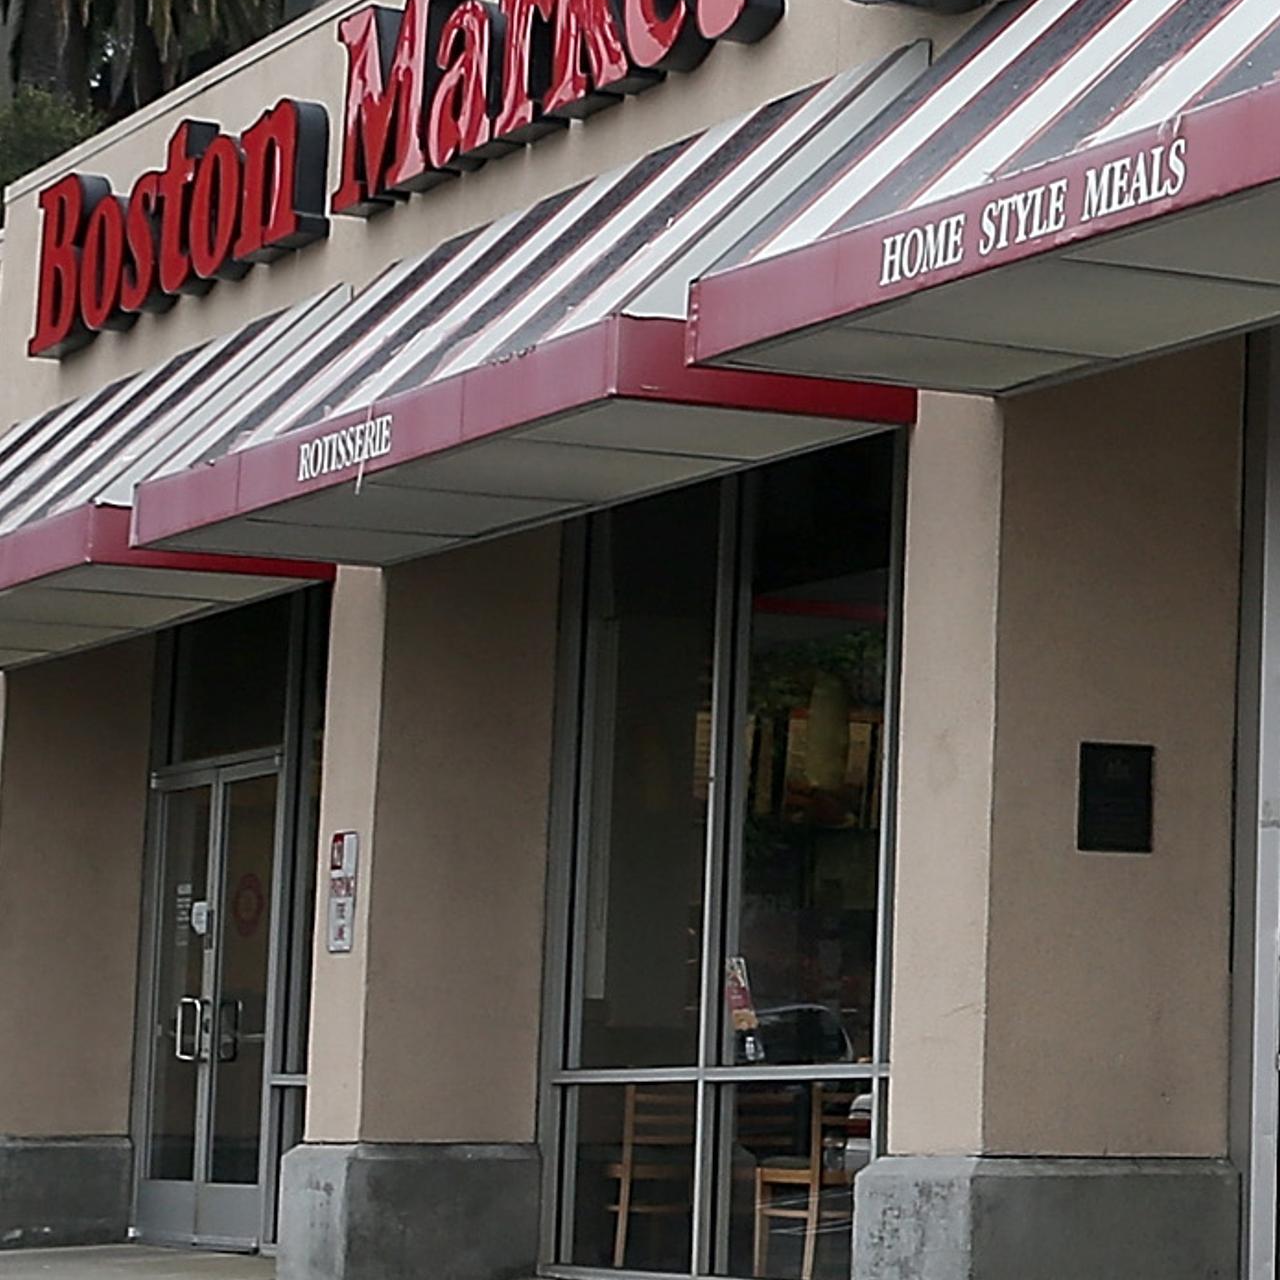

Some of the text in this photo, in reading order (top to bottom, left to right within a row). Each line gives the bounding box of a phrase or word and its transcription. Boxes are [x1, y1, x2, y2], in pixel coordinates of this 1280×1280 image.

[26, 98, 302, 359] Boston
[879, 138, 1187, 286] HOME STYLE MEALS
[297, 414, 393, 482] ROTISSERIE
